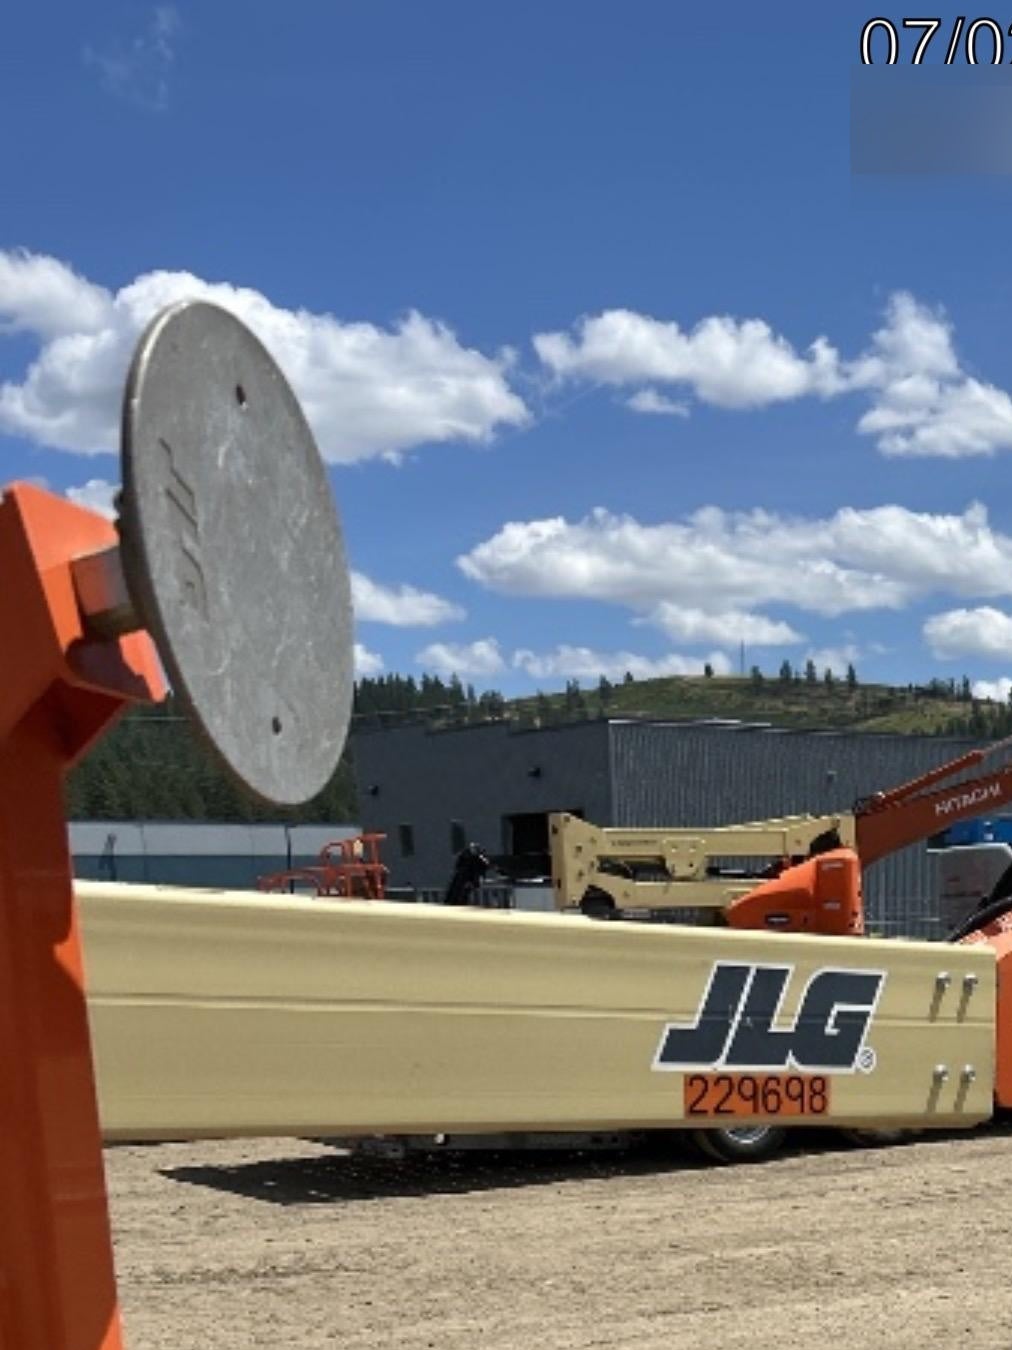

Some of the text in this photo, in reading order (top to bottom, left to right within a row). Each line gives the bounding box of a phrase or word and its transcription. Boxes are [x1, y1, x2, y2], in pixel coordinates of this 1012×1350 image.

[934, 783, 1002, 816] HITACHI
[653, 961, 887, 1072] JLG
[687, 1075, 829, 1115] 229698
